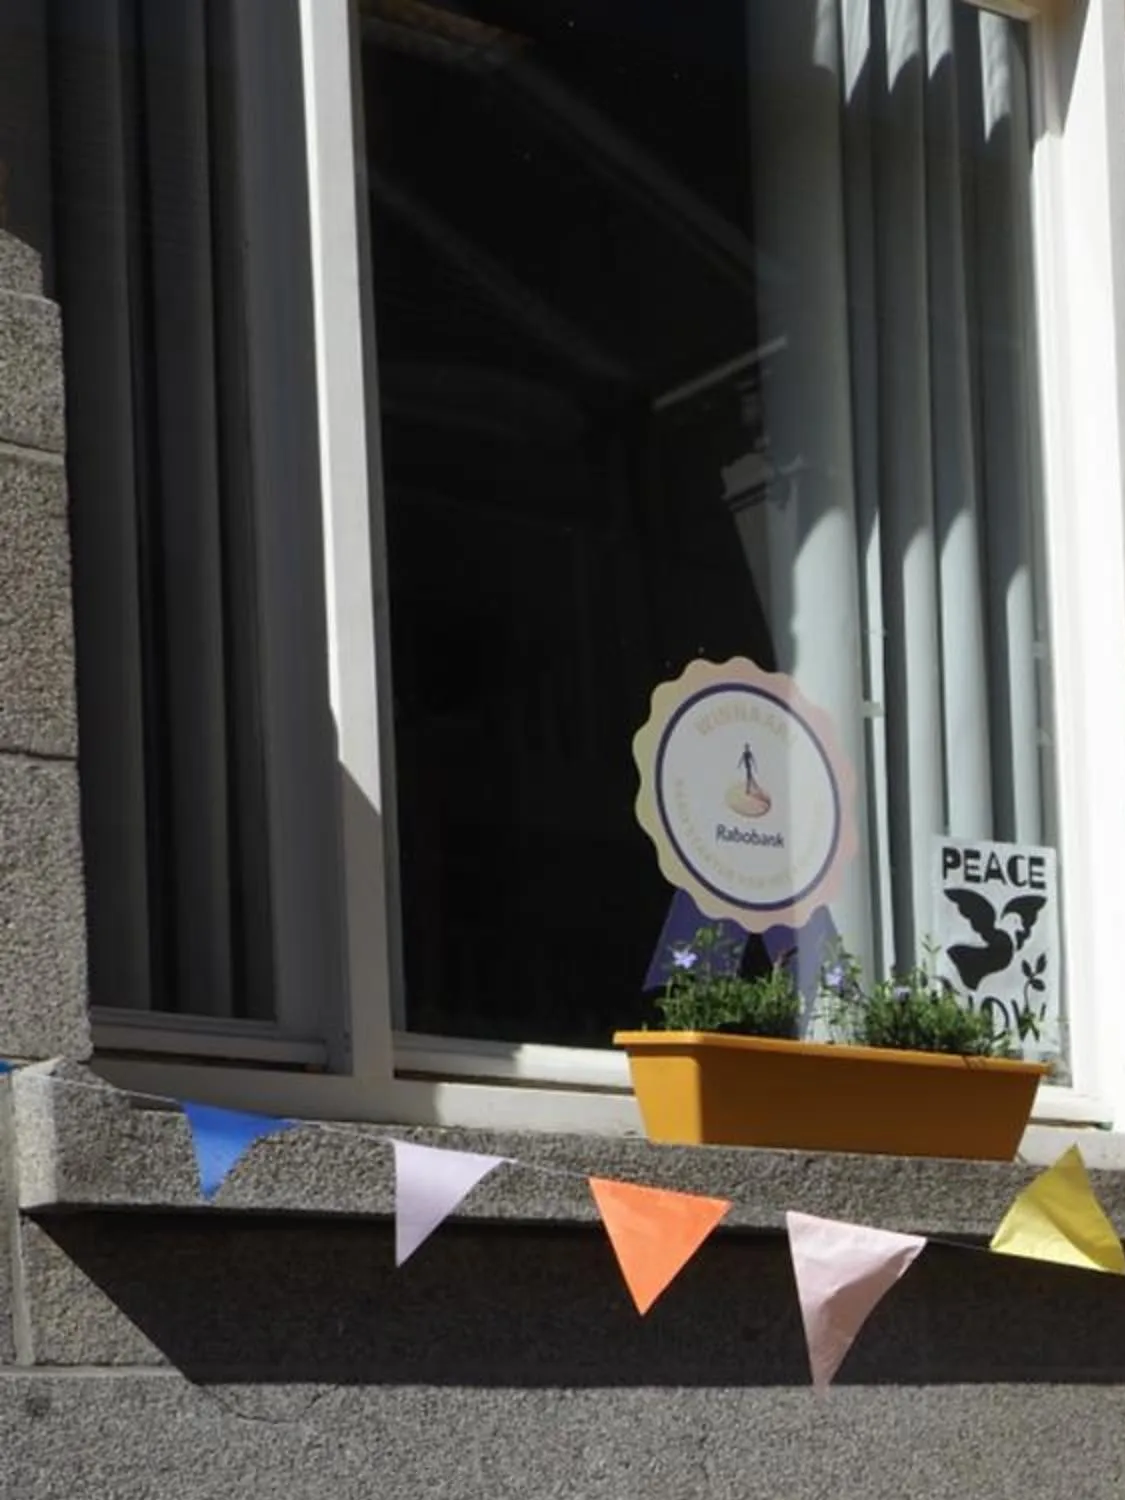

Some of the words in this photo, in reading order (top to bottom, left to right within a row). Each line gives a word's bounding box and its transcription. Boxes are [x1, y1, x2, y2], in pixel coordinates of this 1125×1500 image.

[714, 823, 785, 850] Rabobank
[941, 847, 1047, 890] PEACE
[966, 994, 1047, 1042] OW
